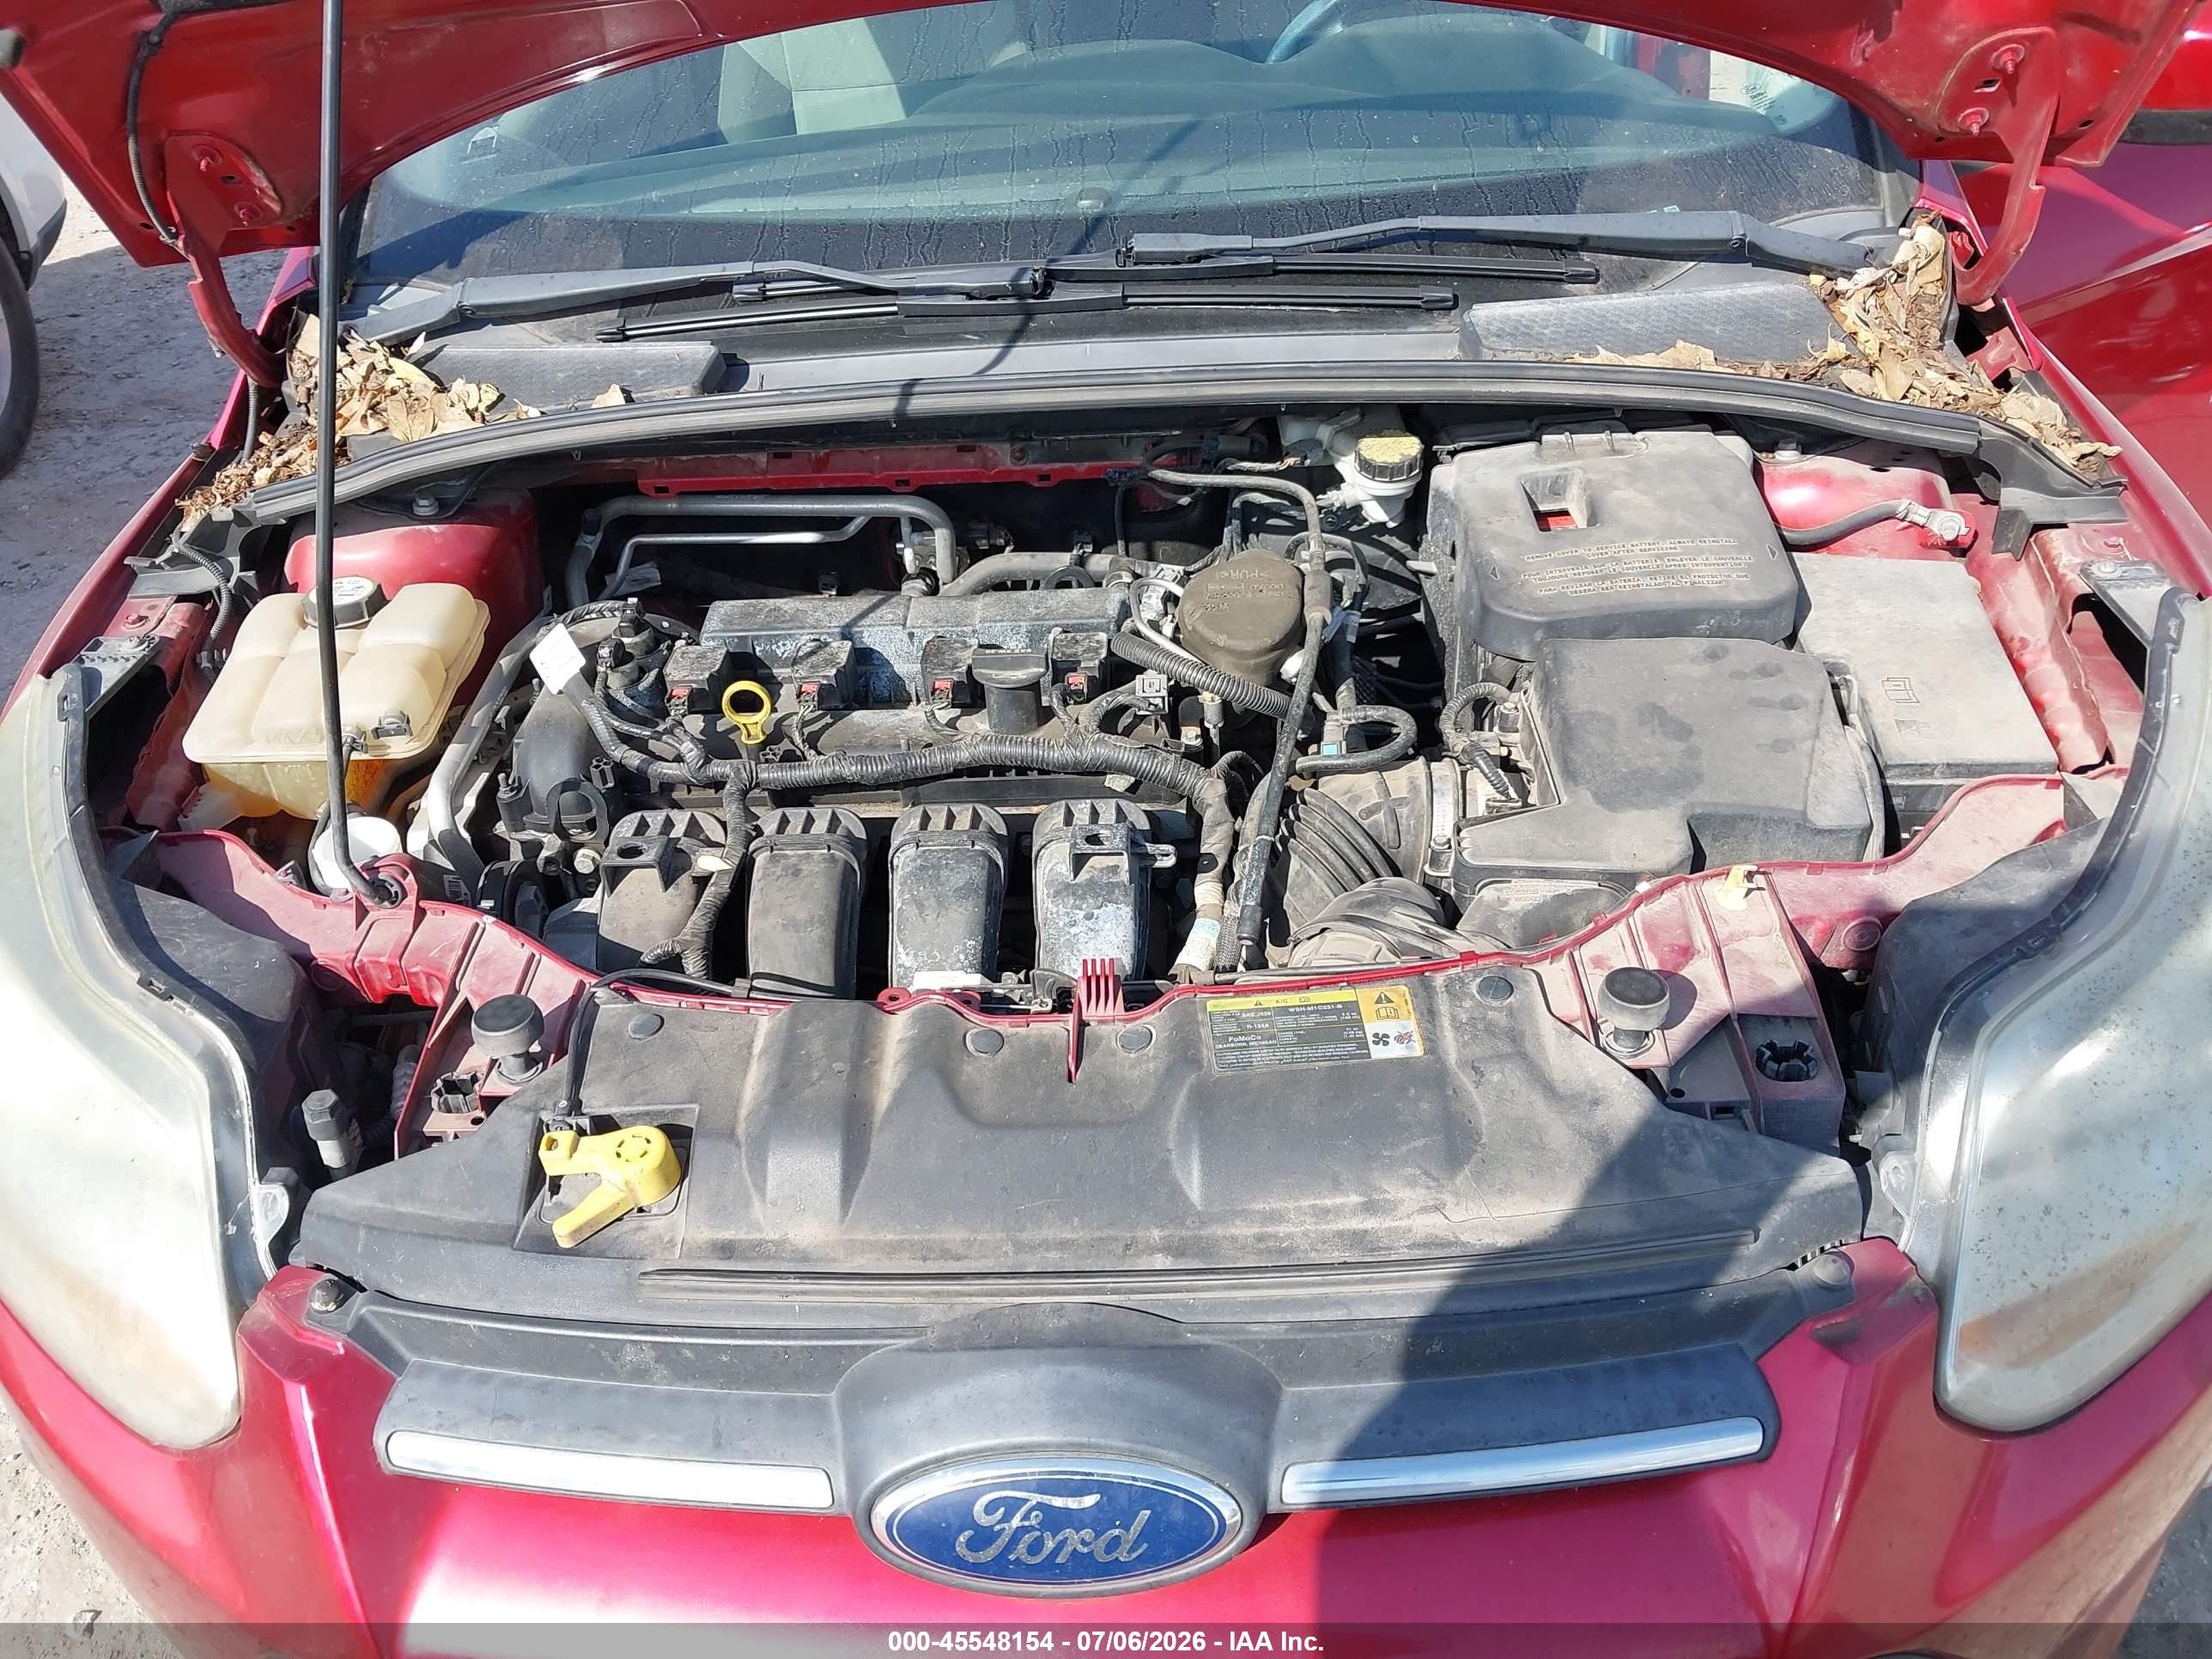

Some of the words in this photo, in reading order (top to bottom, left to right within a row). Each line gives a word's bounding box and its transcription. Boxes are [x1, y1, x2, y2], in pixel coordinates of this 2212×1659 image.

[1556, 549, 1579, 557] COVER
[1228, 1034, 1262, 1042] FoMoCo
[955, 1490, 1152, 1565] Ford
